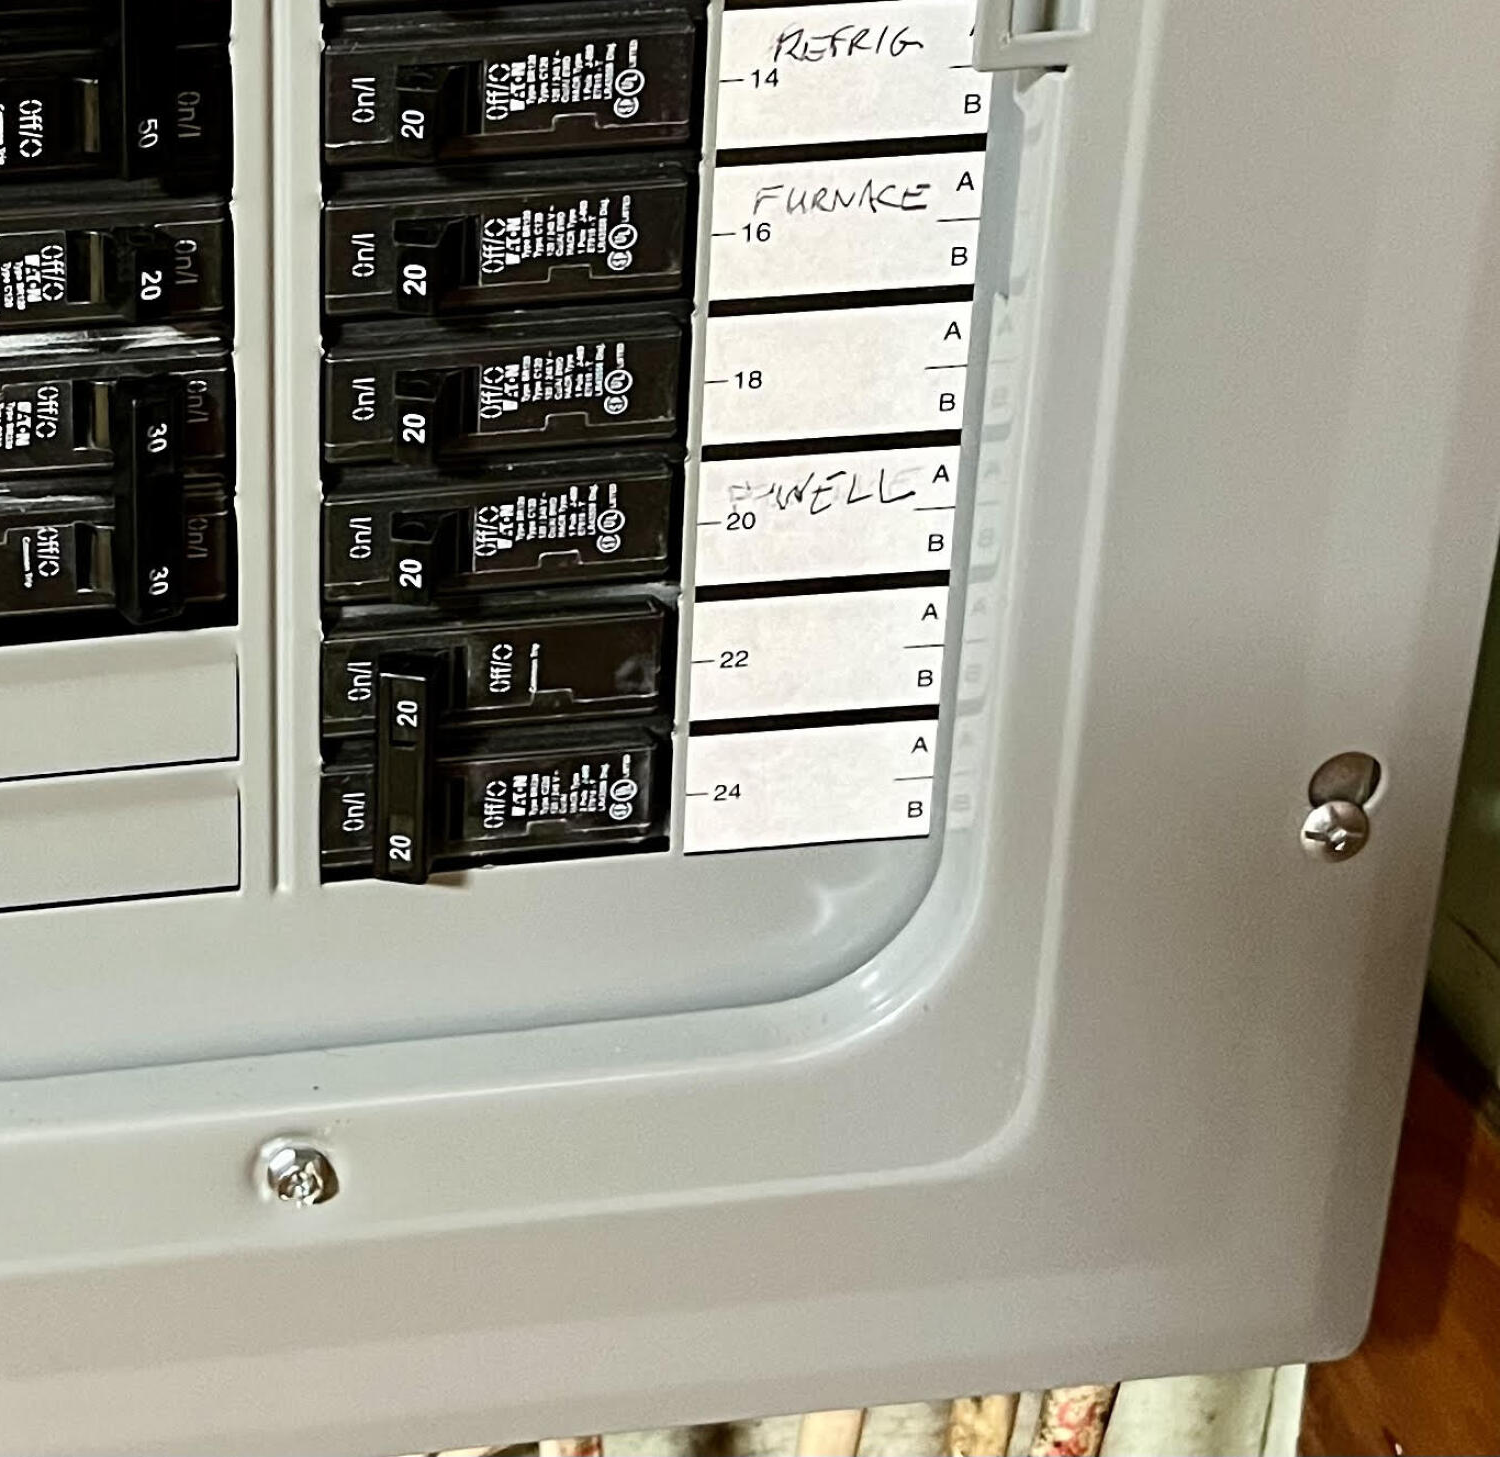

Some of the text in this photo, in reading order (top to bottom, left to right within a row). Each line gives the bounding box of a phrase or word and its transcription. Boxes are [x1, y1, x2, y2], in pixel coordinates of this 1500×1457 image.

[774, 25, 923, 62] REFRIG
[752, 68, 778, 88] 14
[964, 94, 981, 114] B
[139, 119, 158, 149] 50
[401, 110, 423, 139] 20
[956, 171, 974, 191] A
[754, 180, 930, 215] FURNACE
[743, 223, 770, 242] 16
[952, 247, 967, 266] B
[141, 271, 162, 301] 20
[404, 264, 426, 296] 20
[944, 321, 961, 340] A
[736, 371, 762, 389] 18
[940, 393, 955, 411] B
[148, 423, 167, 453] 30
[403, 413, 425, 443] 20
[933, 465, 949, 483] A
[727, 512, 756, 530] 20
[928, 534, 943, 551] B
[149, 565, 168, 596] 30
[401, 559, 421, 588] 20
[922, 603, 937, 620] A
[720, 650, 748, 668] 22
[918, 670, 932, 687] B
[397, 700, 417, 727] 20
[912, 737, 927, 753] A
[714, 784, 740, 801] 24
[908, 801, 923, 818] B
[390, 835, 411, 862] 20
